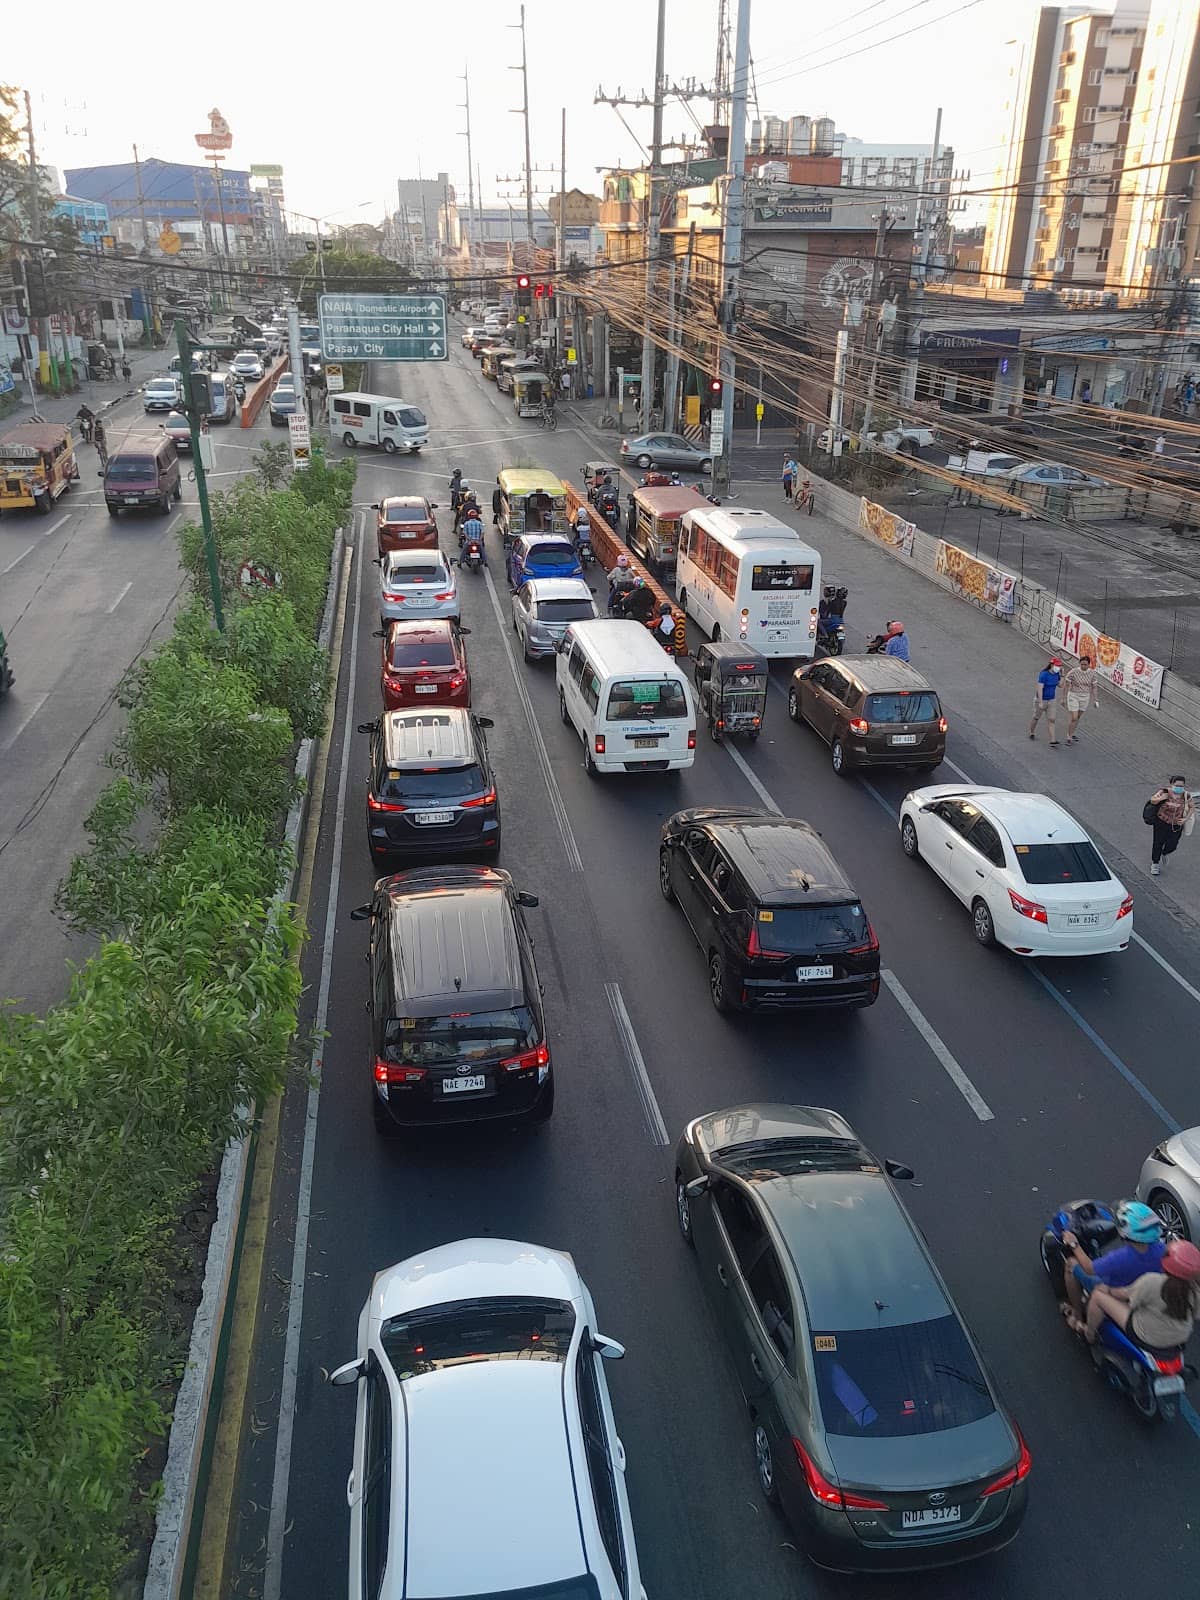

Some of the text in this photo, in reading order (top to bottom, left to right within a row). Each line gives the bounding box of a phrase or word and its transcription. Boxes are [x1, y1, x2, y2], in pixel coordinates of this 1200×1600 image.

[534, 283, 554, 299] 21
[324, 301, 353, 312] NAIA
[399, 304, 428, 315] Airport
[382, 323, 402, 336] City
[404, 323, 424, 334] Hall
[327, 343, 385, 356] Pasay City
[290, 415, 306, 423] STOP
[291, 424, 308, 432] HERE
[1063, 614, 1081, 654] 1+1
[443, 1080, 460, 1090] NAE
